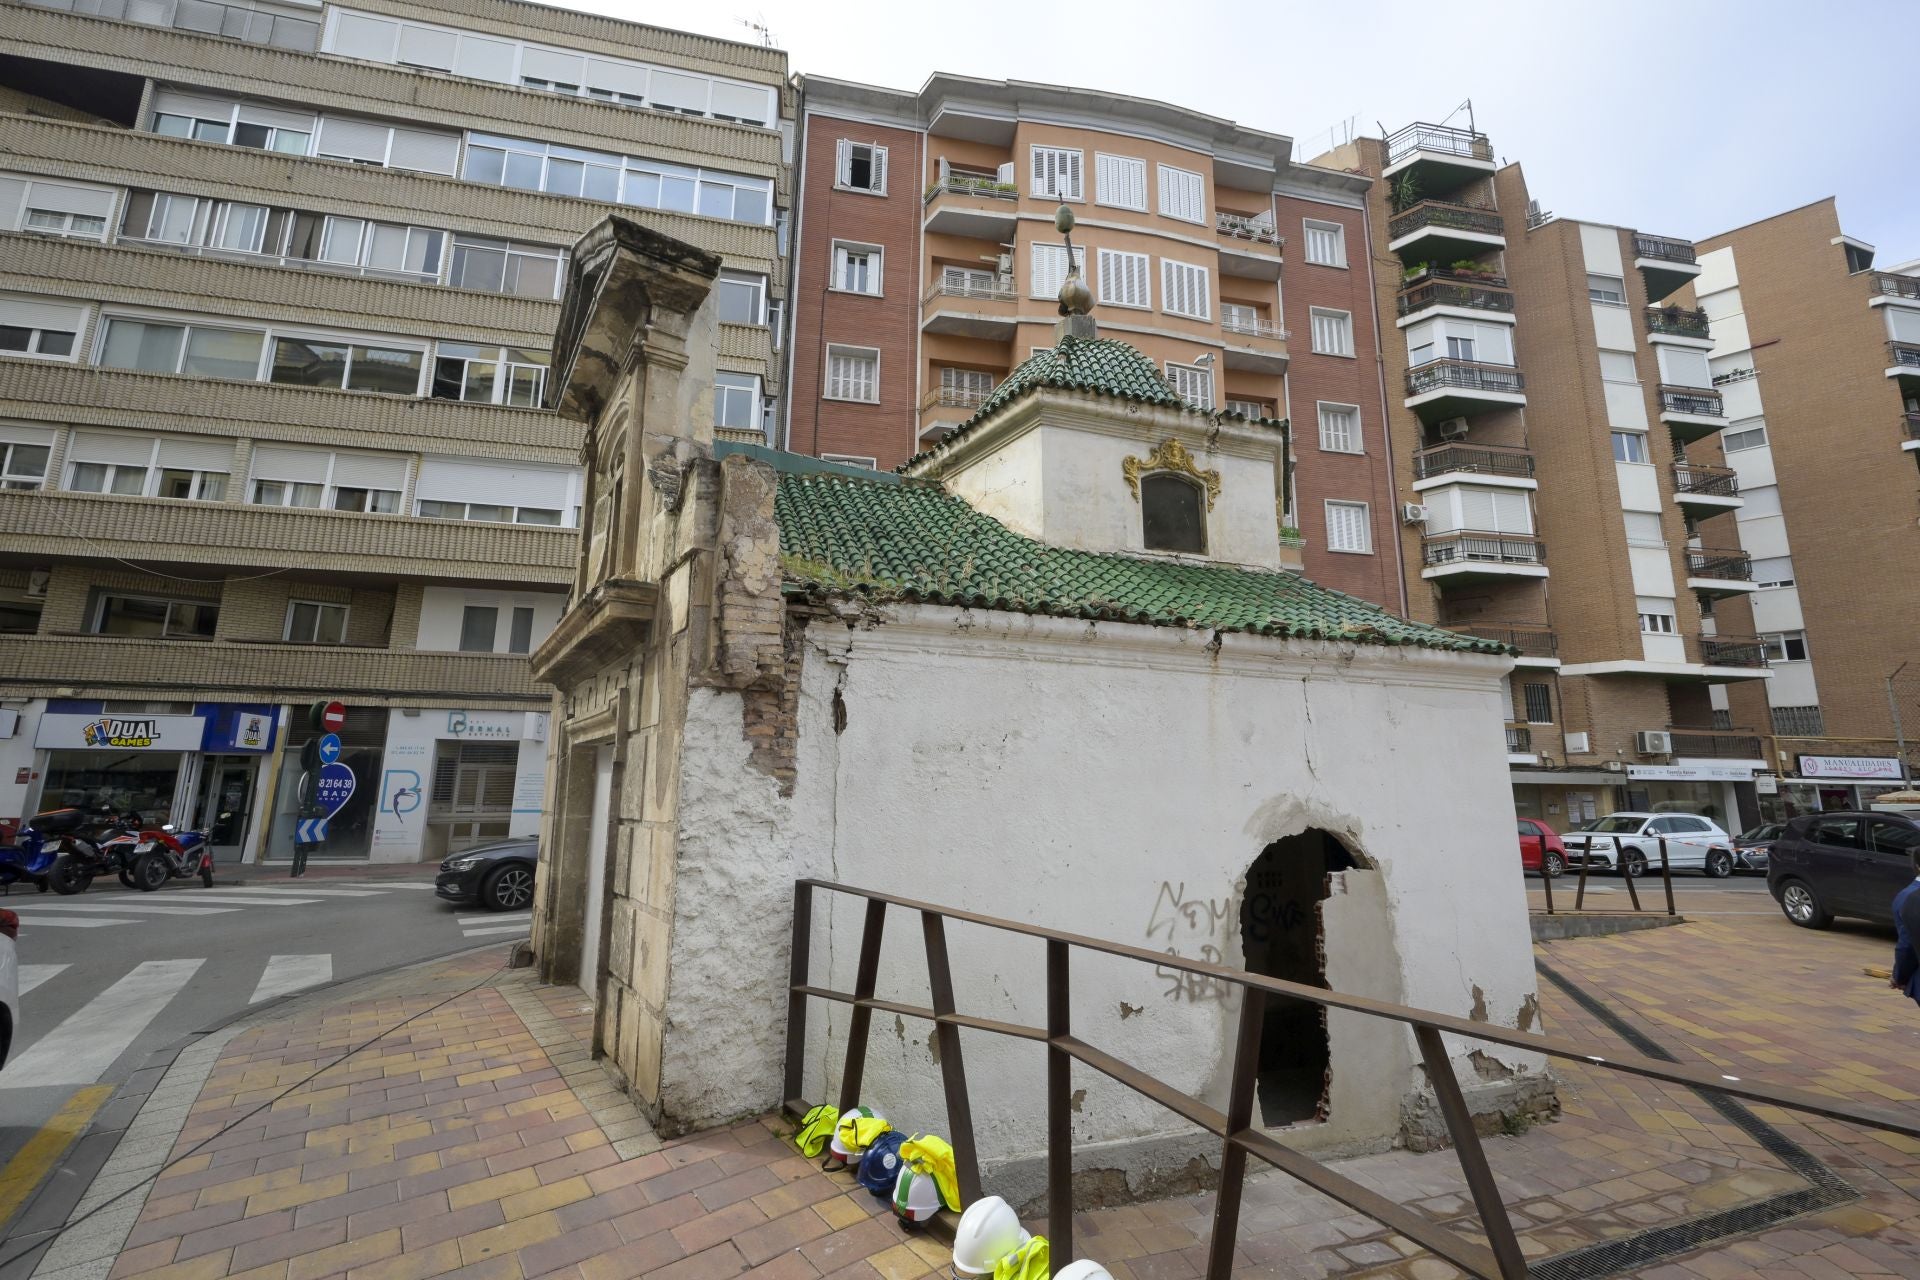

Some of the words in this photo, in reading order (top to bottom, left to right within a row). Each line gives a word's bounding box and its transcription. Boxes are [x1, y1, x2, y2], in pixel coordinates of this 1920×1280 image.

[107, 719, 160, 739] DUAL
[243, 730, 261, 741] DUAL
[110, 737, 151, 747] GAMES
[1824, 758, 1892, 768] MANUALIDADES
[326, 779, 333, 788] 21
[333, 779, 342, 788] 64
[343, 780, 352, 788] 38
